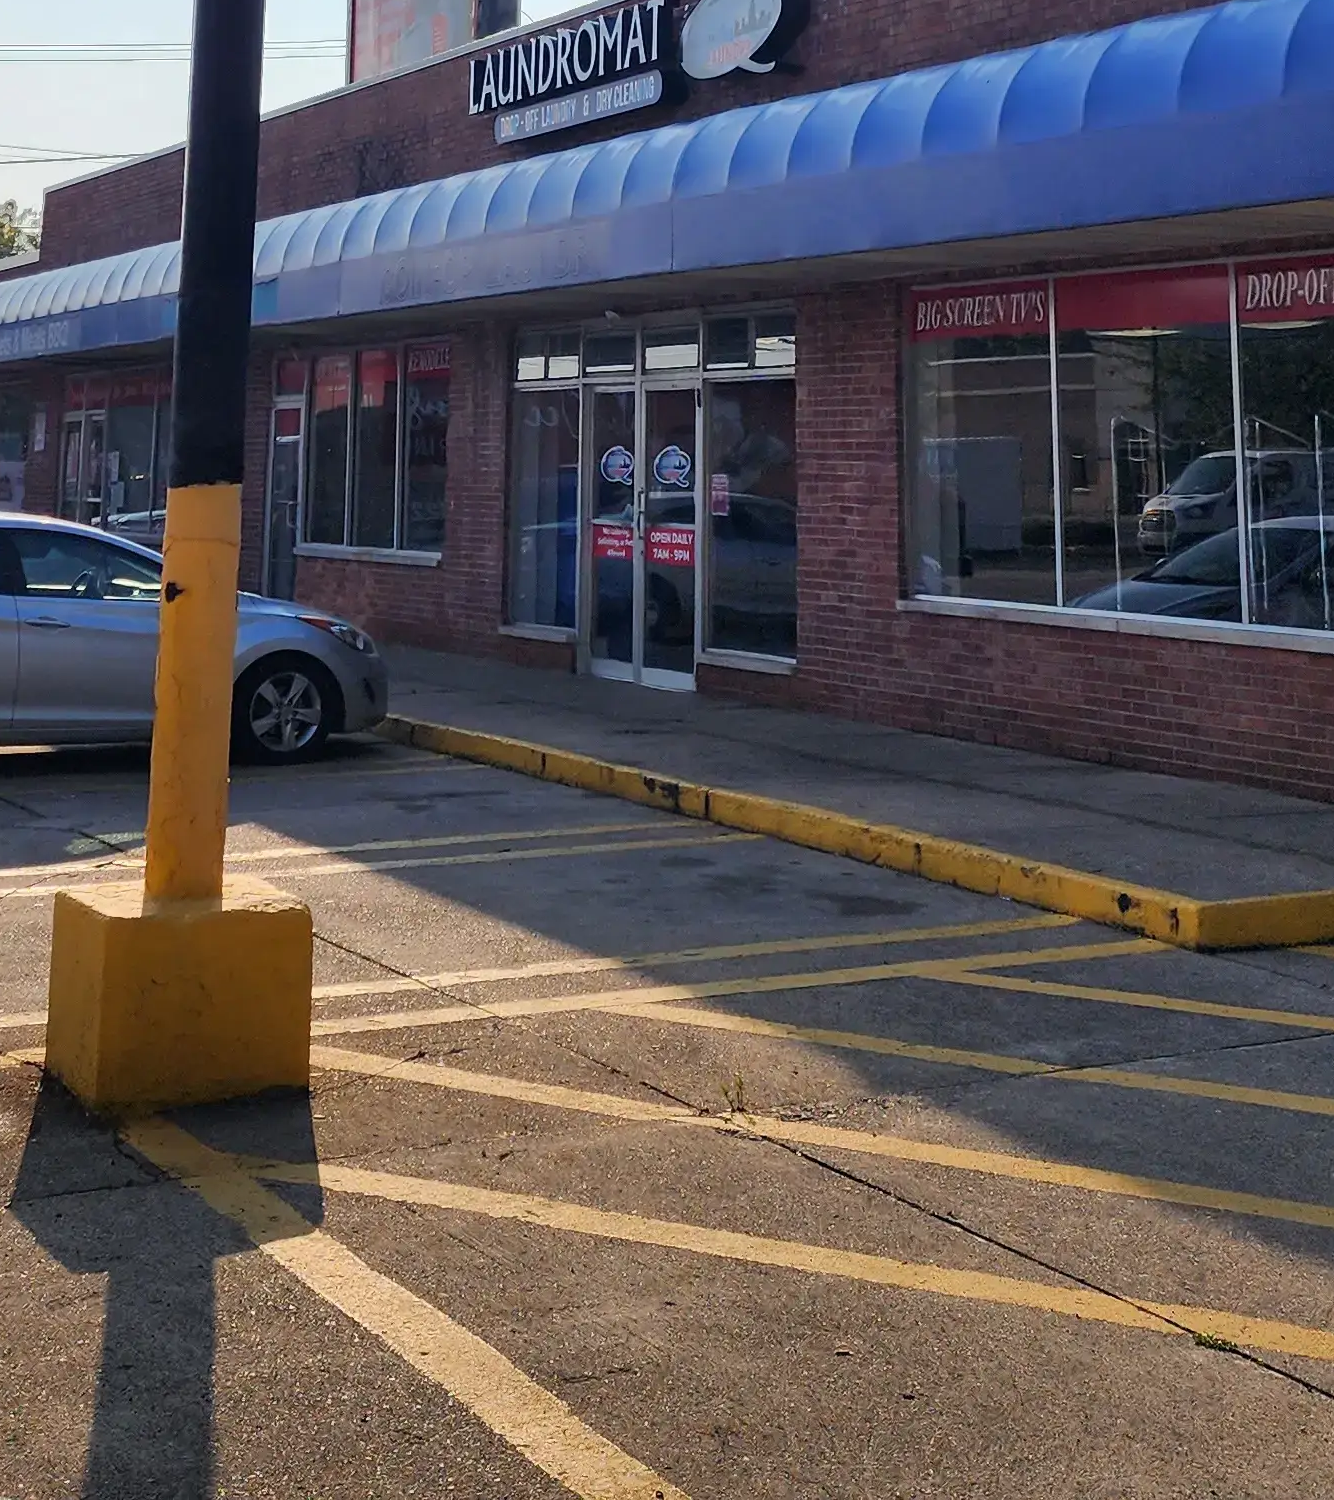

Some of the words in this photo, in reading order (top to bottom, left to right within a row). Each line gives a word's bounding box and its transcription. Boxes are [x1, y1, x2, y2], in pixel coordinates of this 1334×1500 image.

[541, 98, 578, 127] LAUNDRY
[583, 94, 590, 116] &
[917, 300, 942, 332] BIG
[943, 294, 1007, 328] SCREEN
[1011, 291, 1046, 325] TV'S
[650, 532, 672, 545] OPEN
[672, 532, 694, 546] DAILY
[652, 548, 669, 560] 7AM
[674, 549, 690, 562] 9PM
